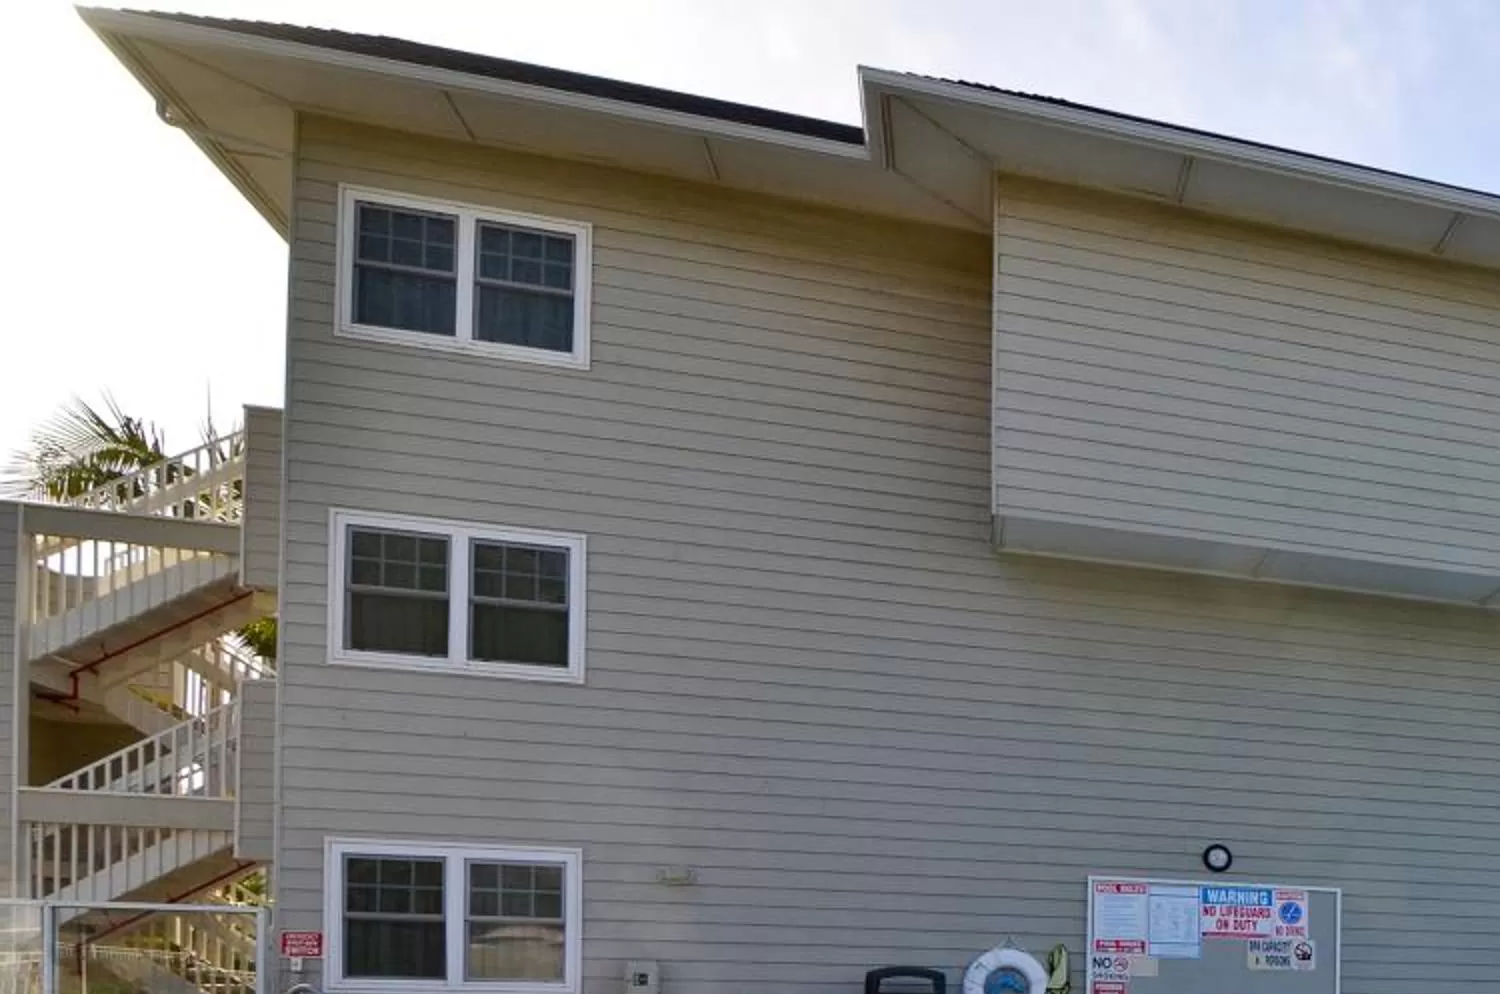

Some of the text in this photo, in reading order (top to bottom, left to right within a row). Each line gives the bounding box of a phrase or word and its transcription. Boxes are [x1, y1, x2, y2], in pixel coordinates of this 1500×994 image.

[1207, 888, 1269, 905] WARNING
[1203, 906, 1271, 919] NO LIFEGUARD
[1216, 918, 1257, 931] ON DUTY
[1092, 956, 1112, 969] NO
